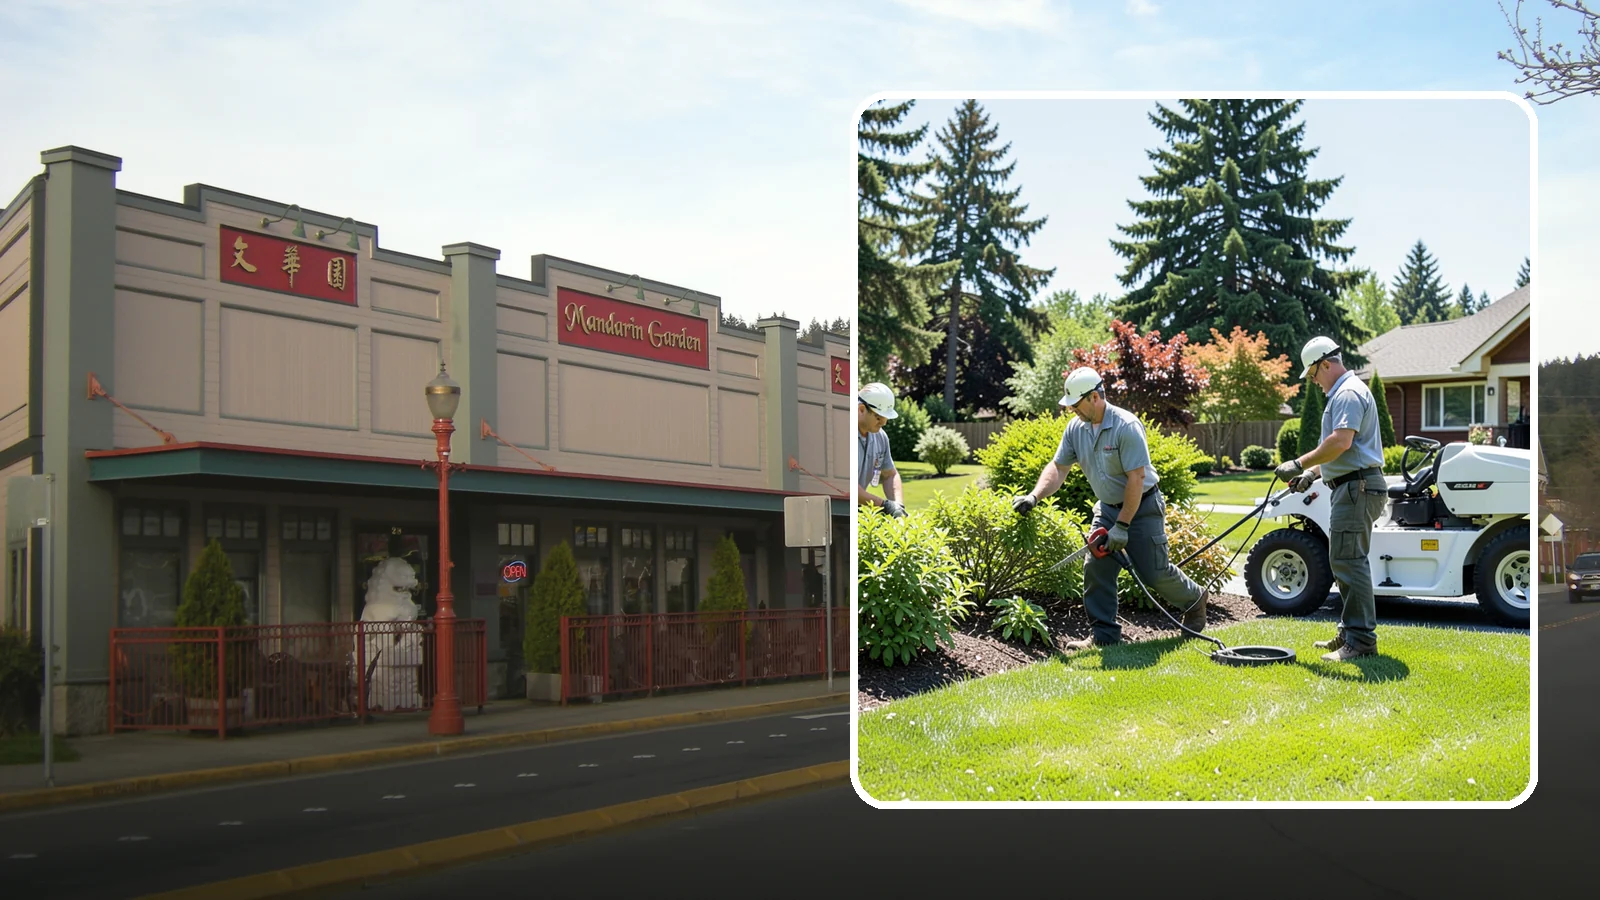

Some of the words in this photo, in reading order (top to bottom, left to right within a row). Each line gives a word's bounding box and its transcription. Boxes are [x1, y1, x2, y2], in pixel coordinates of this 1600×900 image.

[231, 236, 346, 291] 文華園
[565, 302, 643, 340] Mandarin
[648, 320, 701, 352] Garden
[503, 565, 527, 578] OPEN
